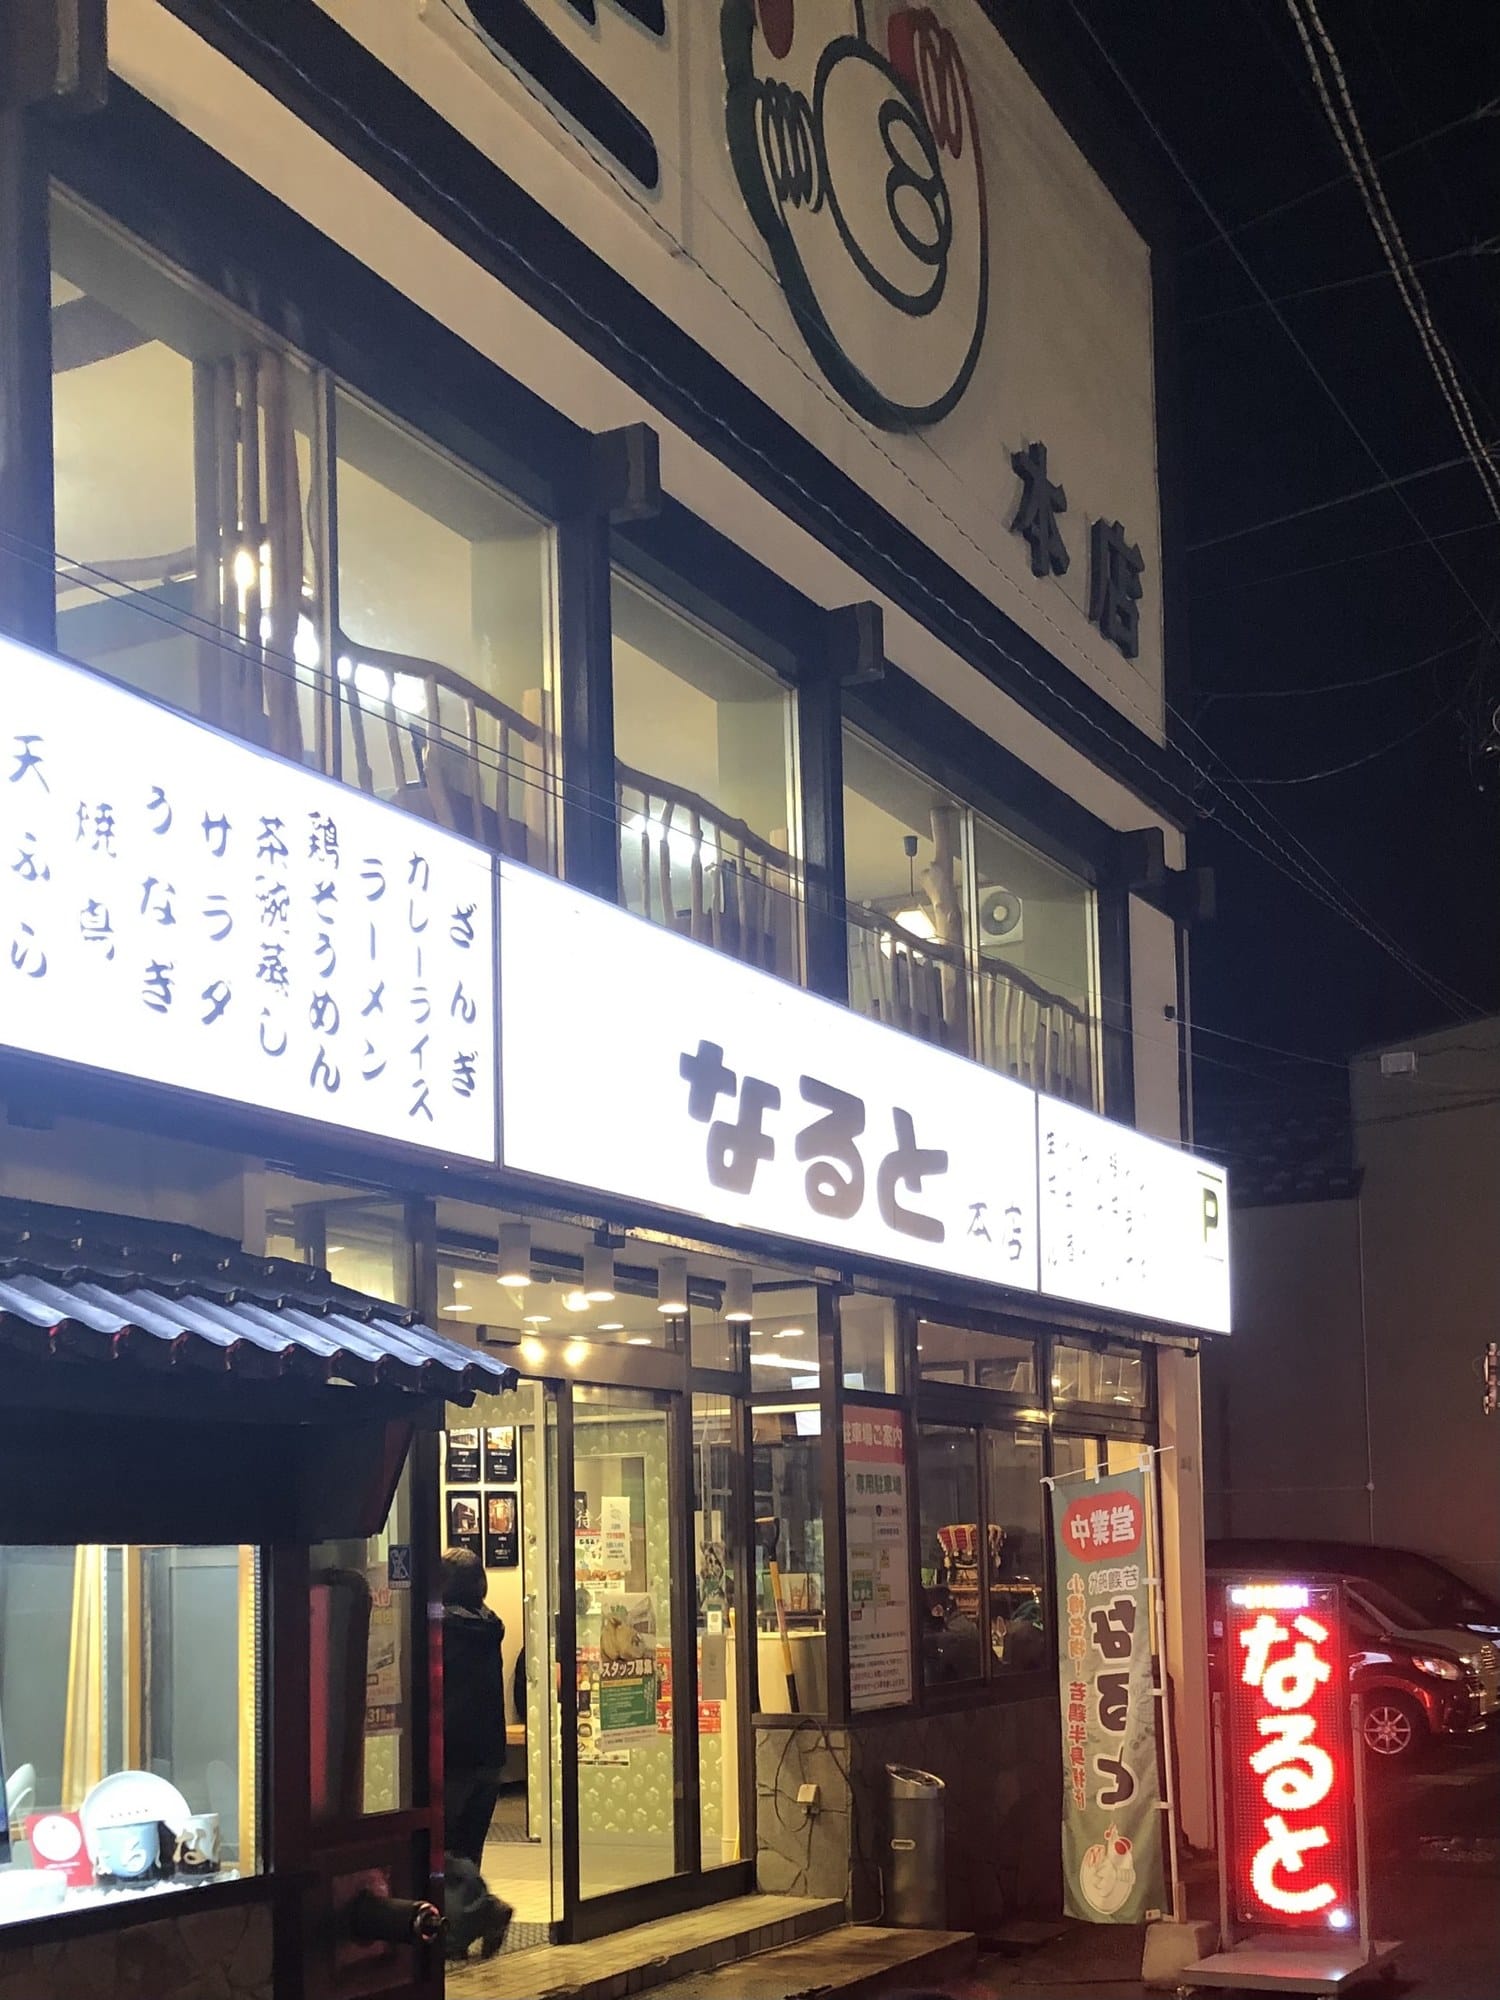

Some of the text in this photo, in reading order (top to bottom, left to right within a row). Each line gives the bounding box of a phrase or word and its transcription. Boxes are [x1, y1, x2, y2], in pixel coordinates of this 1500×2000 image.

[1008, 440, 1147, 660] 本店
[141, 786, 176, 1014] うなぎ
[256, 816, 290, 1057] 茶碗蒸し
[308, 811, 340, 1093] 鶏そうめん
[360, 858, 386, 1081] ラーメン
[408, 852, 433, 1121] カレーライス
[450, 904, 478, 1098] ざんぎ
[680, 1039, 948, 1243] なると
[1240, 1614, 1336, 1913] なると
